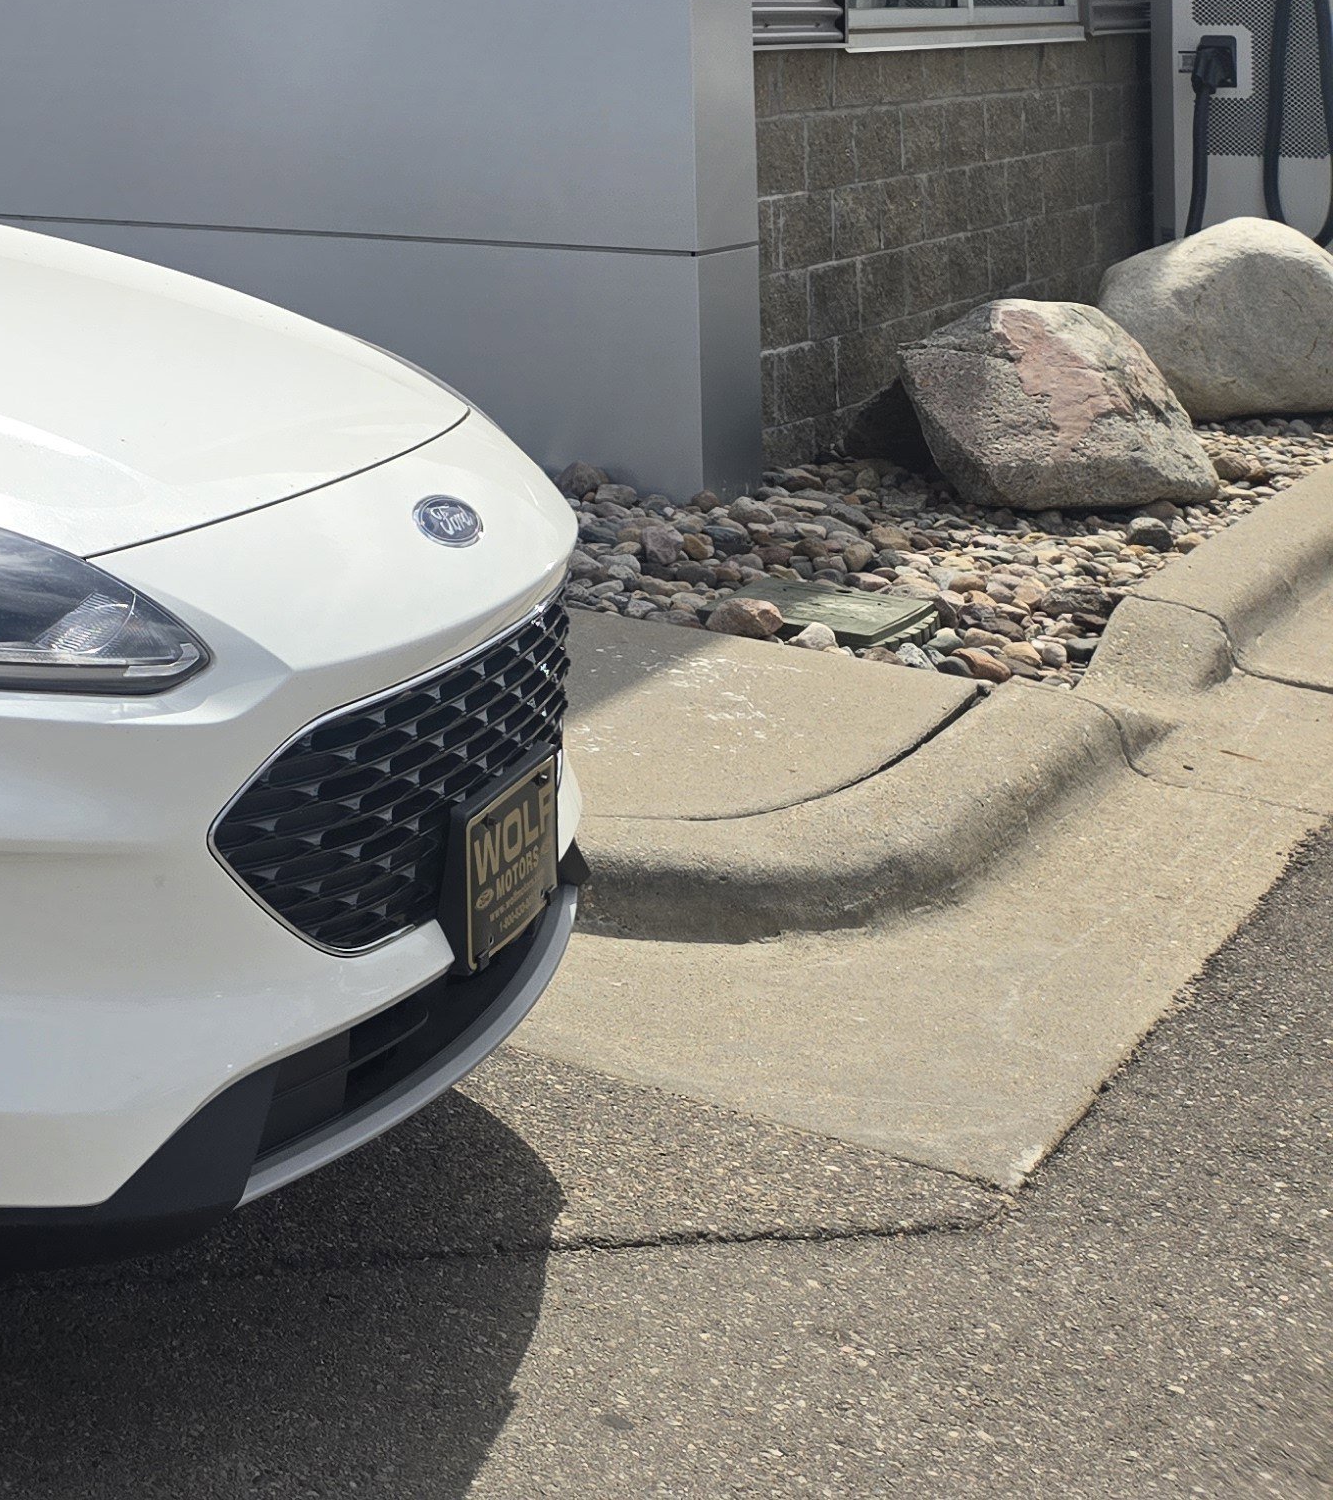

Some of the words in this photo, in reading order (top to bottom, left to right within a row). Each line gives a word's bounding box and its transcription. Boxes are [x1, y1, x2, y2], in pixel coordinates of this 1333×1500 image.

[430, 504, 474, 536] Ford
[474, 782, 554, 886] WOLF
[496, 844, 539, 902] MOTORS
